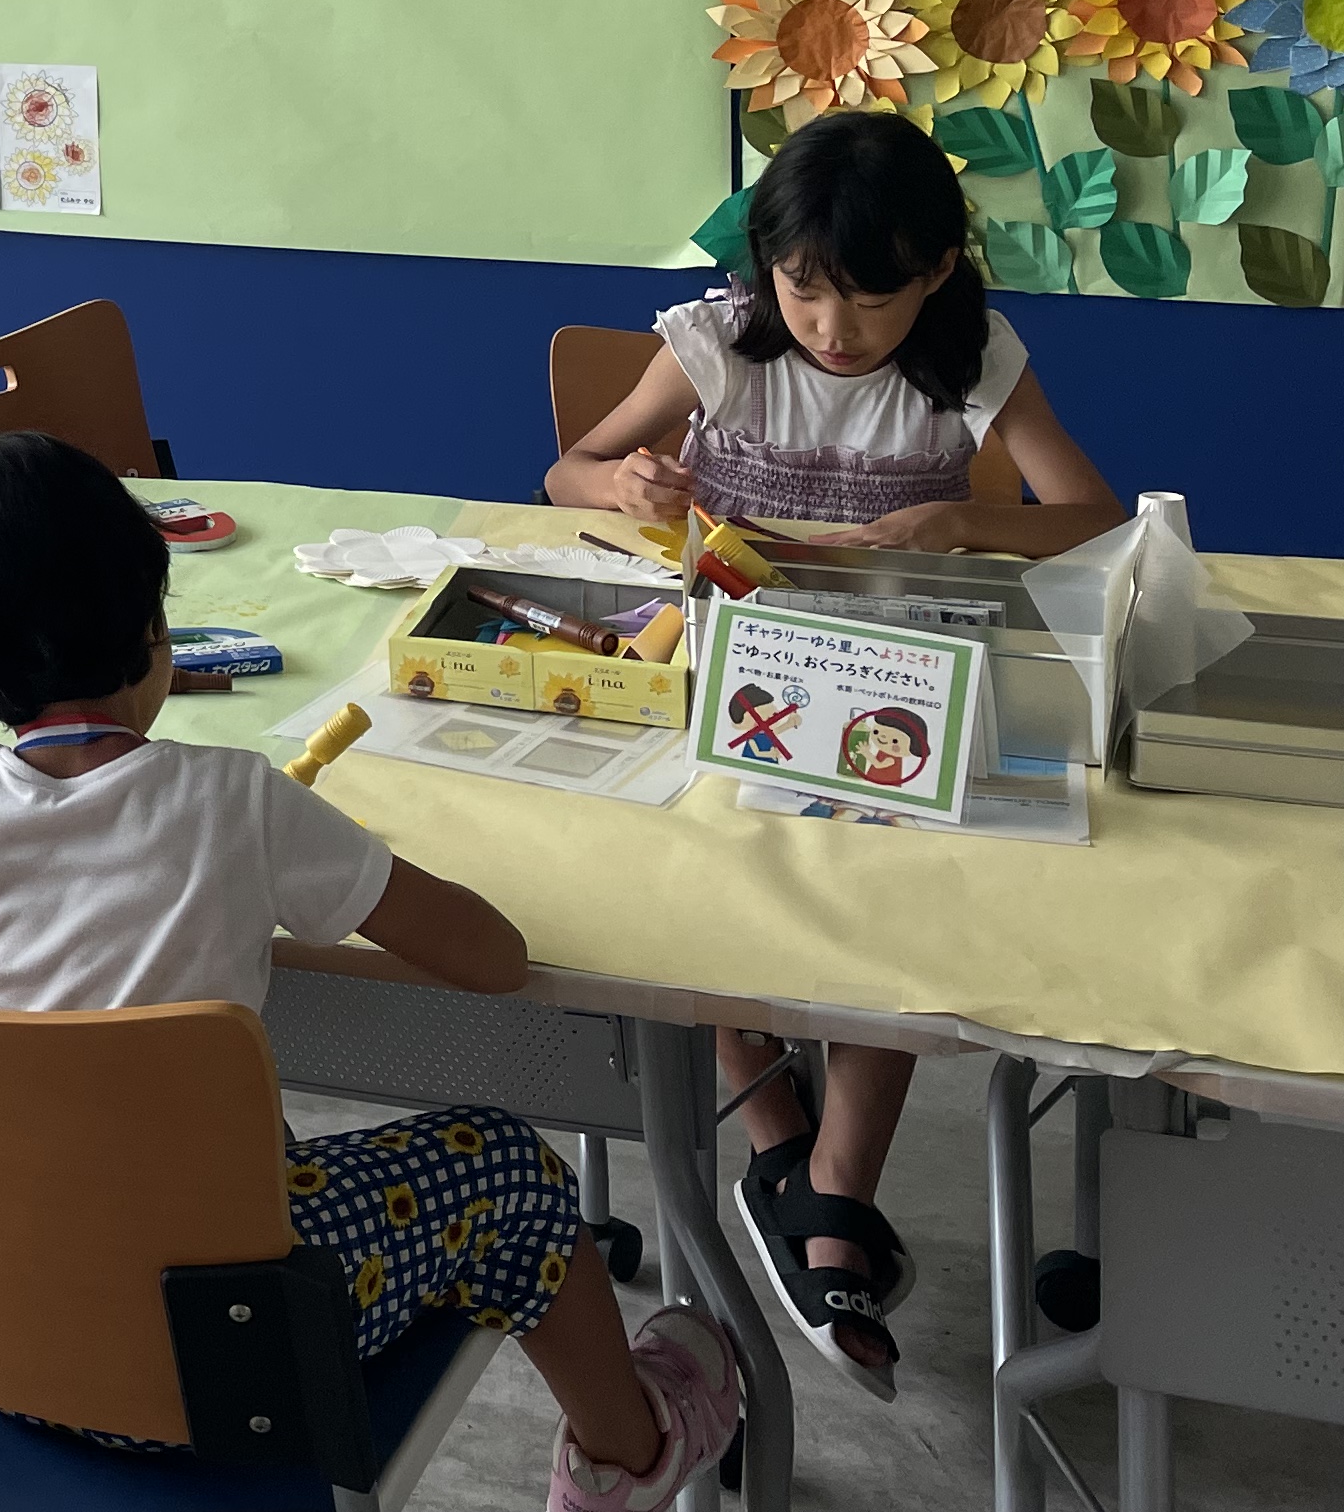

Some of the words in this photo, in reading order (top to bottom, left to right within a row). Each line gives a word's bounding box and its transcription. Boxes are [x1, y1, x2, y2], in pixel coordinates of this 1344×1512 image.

[731, 642, 936, 692] ごゆっくり、おくつろぎください。
